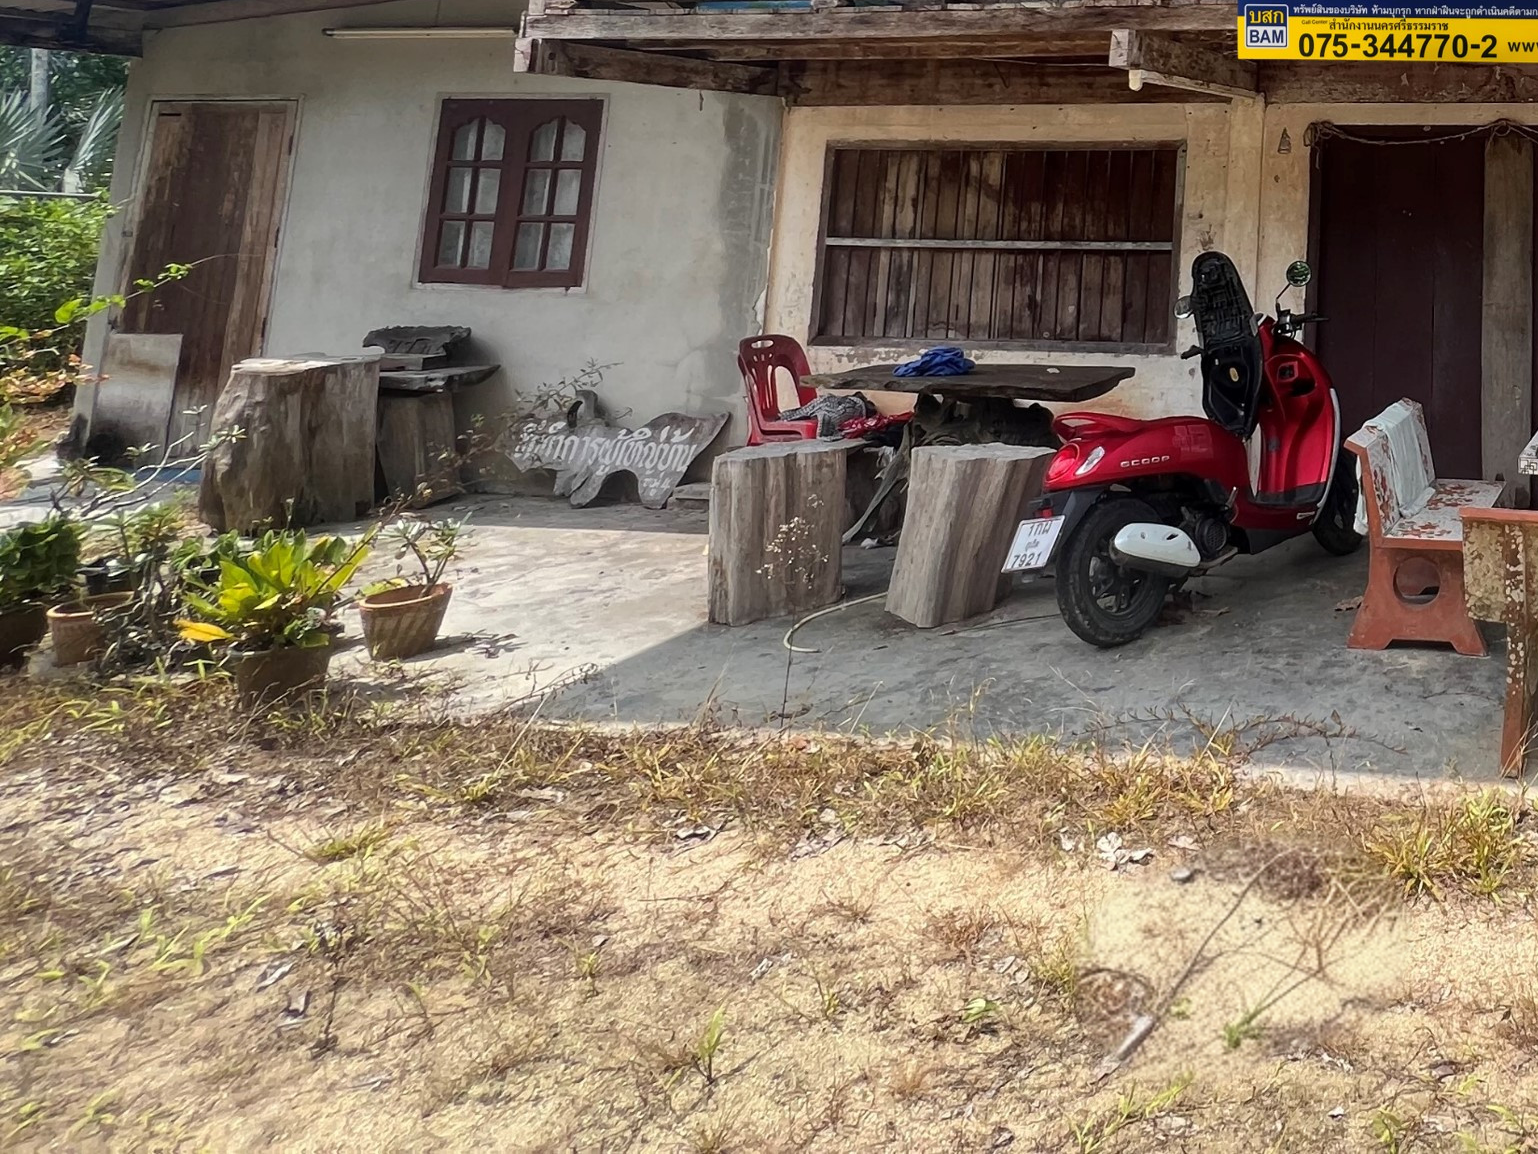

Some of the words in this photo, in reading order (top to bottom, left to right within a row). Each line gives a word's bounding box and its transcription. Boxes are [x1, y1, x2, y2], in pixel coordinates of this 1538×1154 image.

[1249, 10, 1284, 26] บสก
[1293, 3, 1369, 17] ทรัพย์สินของบริษัท
[1372, 4, 1412, 19] ห้ามบุกรุก
[1329, 18, 1449, 32] สำนักงานนครศรีธรรมราช
[1250, 29, 1284, 45] BAM
[1298, 33, 1498, 59] 075-344770-2
[1011, 551, 1042, 568] 7921
